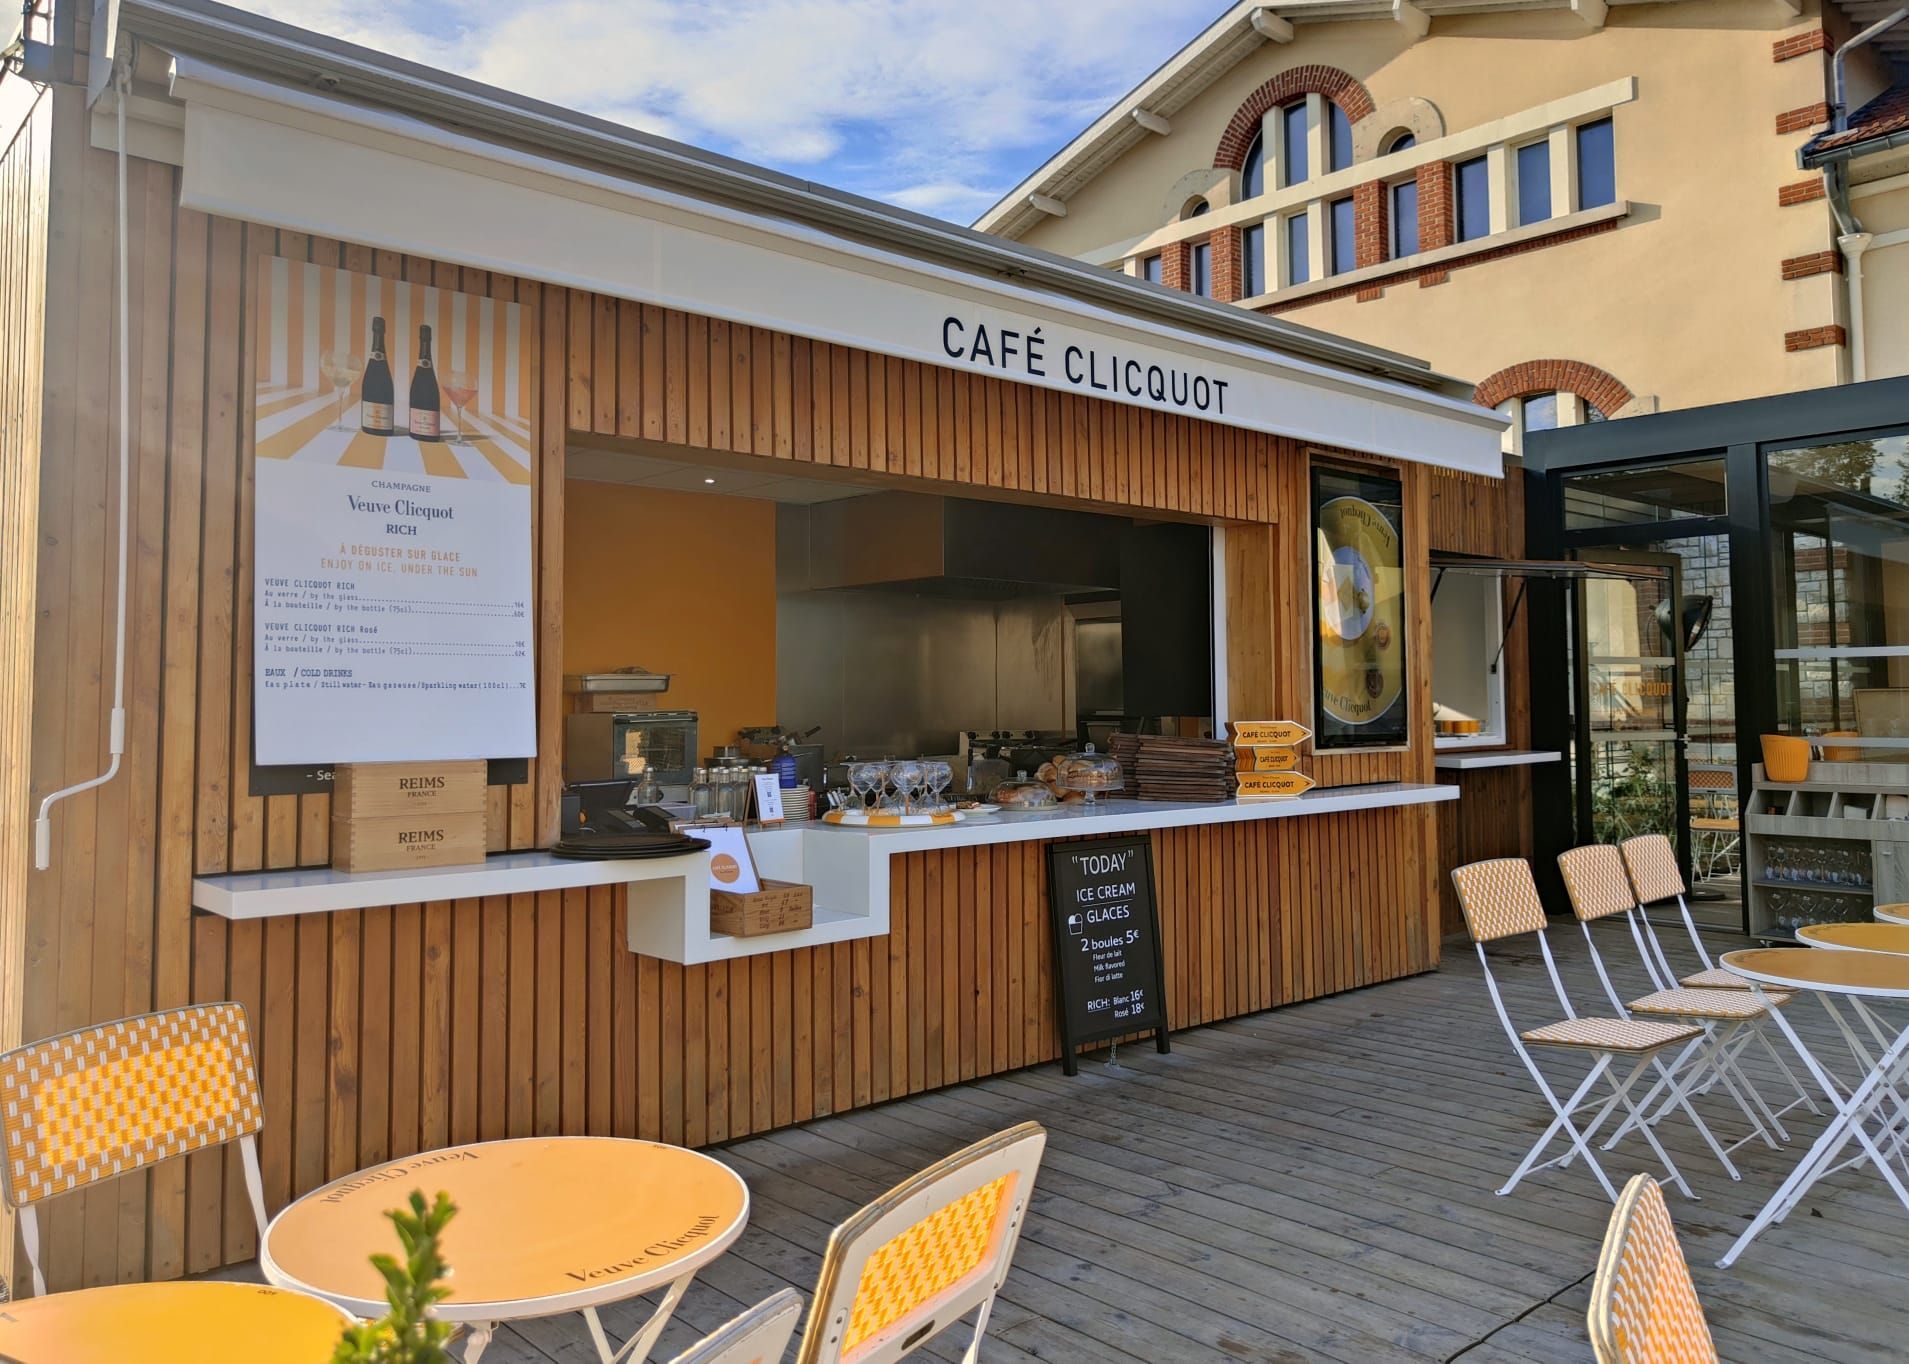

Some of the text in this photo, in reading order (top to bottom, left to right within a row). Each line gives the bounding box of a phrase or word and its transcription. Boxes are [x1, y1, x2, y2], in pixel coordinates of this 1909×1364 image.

[942, 317, 1229, 414] CAFÉ CLICQUOT
[371, 480, 432, 493] CHAMPAGNE
[347, 494, 454, 520] Veuve Clicquot
[386, 523, 418, 536] RICH
[340, 543, 462, 563] À DÉGUSTER SUR GLACE
[320, 558, 353, 570] ENJOY
[358, 560, 372, 570] ON
[401, 562, 434, 575] UNDER
[438, 564, 456, 576] THE
[458, 566, 479, 578] SUN
[265, 577, 356, 591] VEUVE CLICQUOT RICH
[323, 592, 336, 600] the
[347, 604, 359, 612] the
[265, 622, 379, 635] VEUVE CLICQUOT RICH Rosé
[264, 668, 287, 677] EAUX
[301, 669, 321, 678] COLD
[323, 669, 353, 678] DRINKS
[1259, 731, 1292, 739] CLICQUOT
[399, 776, 446, 790] REIMS
[1262, 781, 1295, 789] CLICQUOT
[407, 790, 438, 798] FRANCE
[398, 829, 445, 844] REIMS
[406, 843, 437, 852] FRANCE
[1076, 882, 1136, 903] ICE CREAM
[1086, 904, 1130, 924] GLACES
[1081, 929, 1140, 952] 2 boules 5€
[1092, 949, 1123, 961] Fleur de lait
[1093, 960, 1126, 973] Milk flavored
[1094, 971, 1124, 984] Fior di latte
[1087, 989, 1144, 1011] RICH: Blanc 16€
[1114, 1002, 1145, 1019] Rosé 18€
[319, 1151, 480, 1204] Veuve Clicquot
[565, 1215, 721, 1283] Veuve Clicquot
